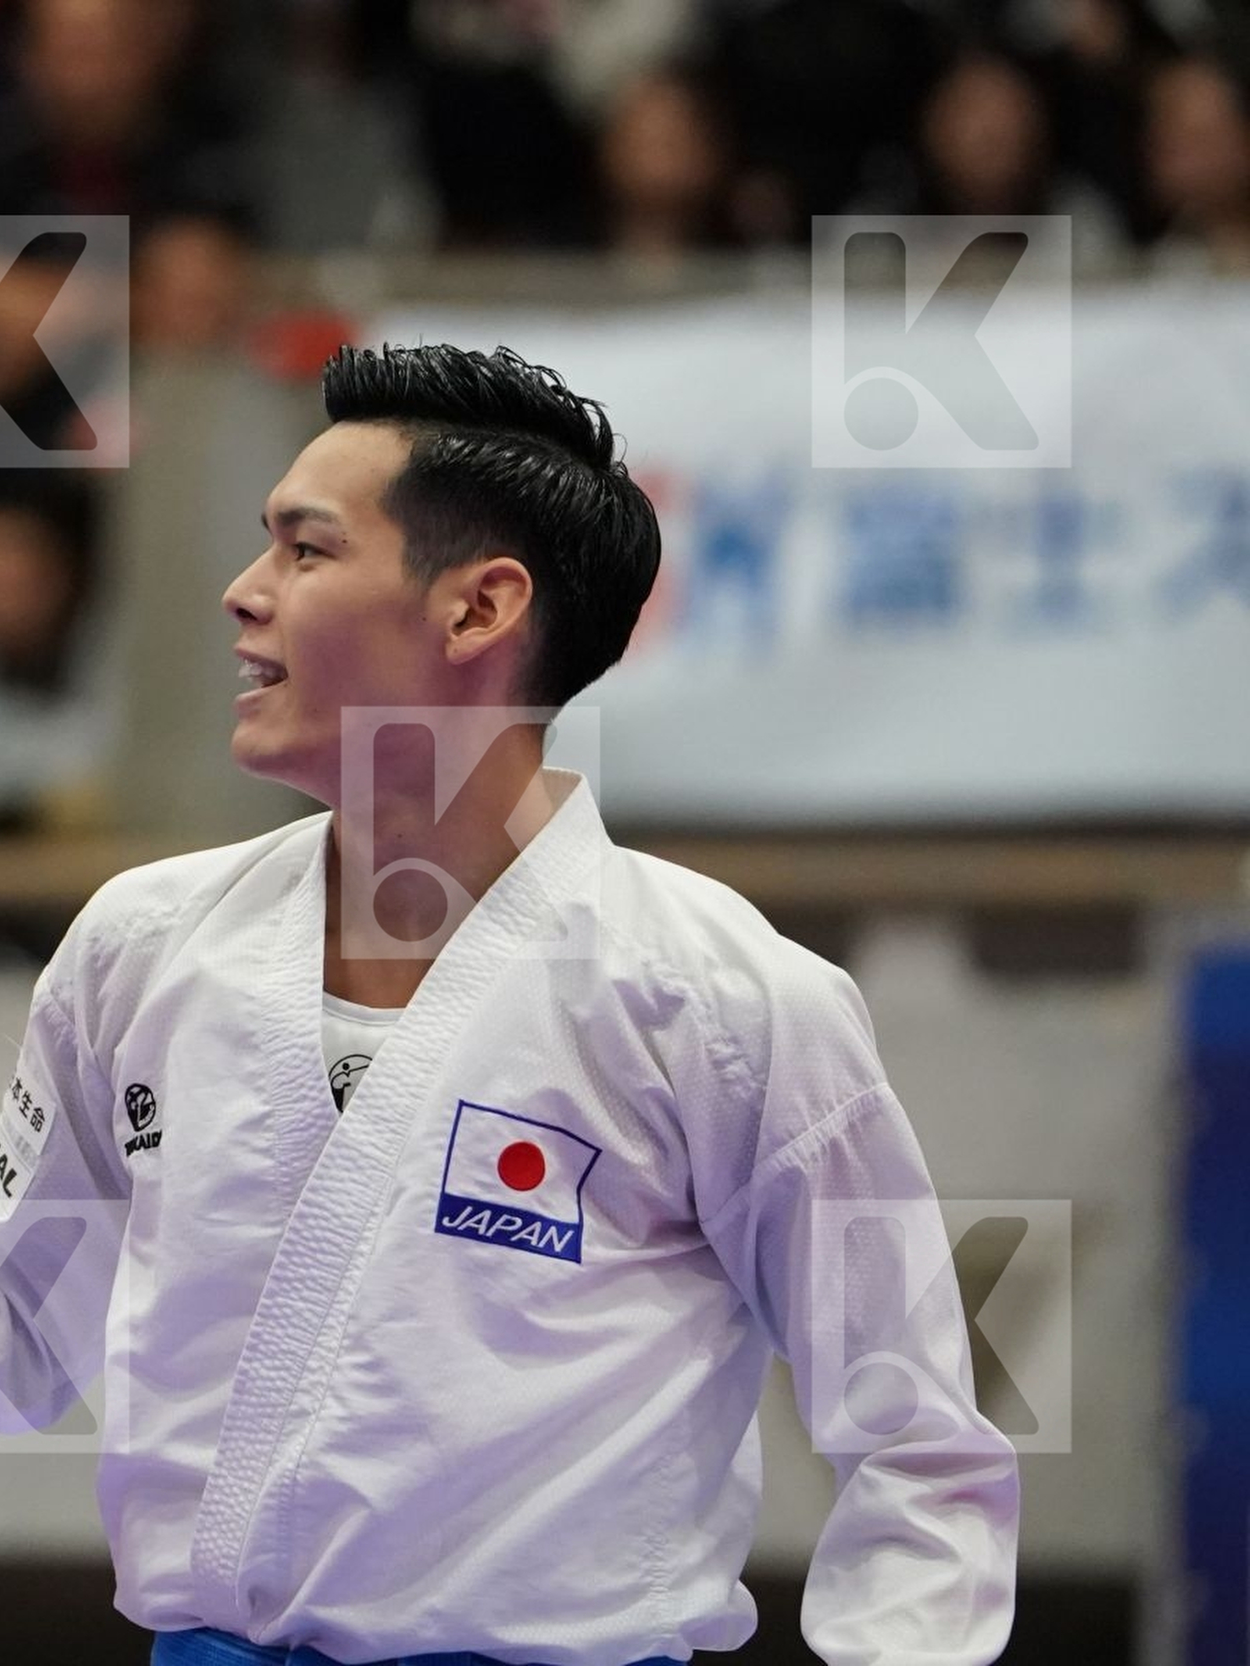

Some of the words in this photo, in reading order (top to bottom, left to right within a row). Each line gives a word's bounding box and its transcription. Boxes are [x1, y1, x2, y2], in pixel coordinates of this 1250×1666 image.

[9, 1077, 45, 1132] 本生命
[442, 1206, 574, 1252] JAPAN
